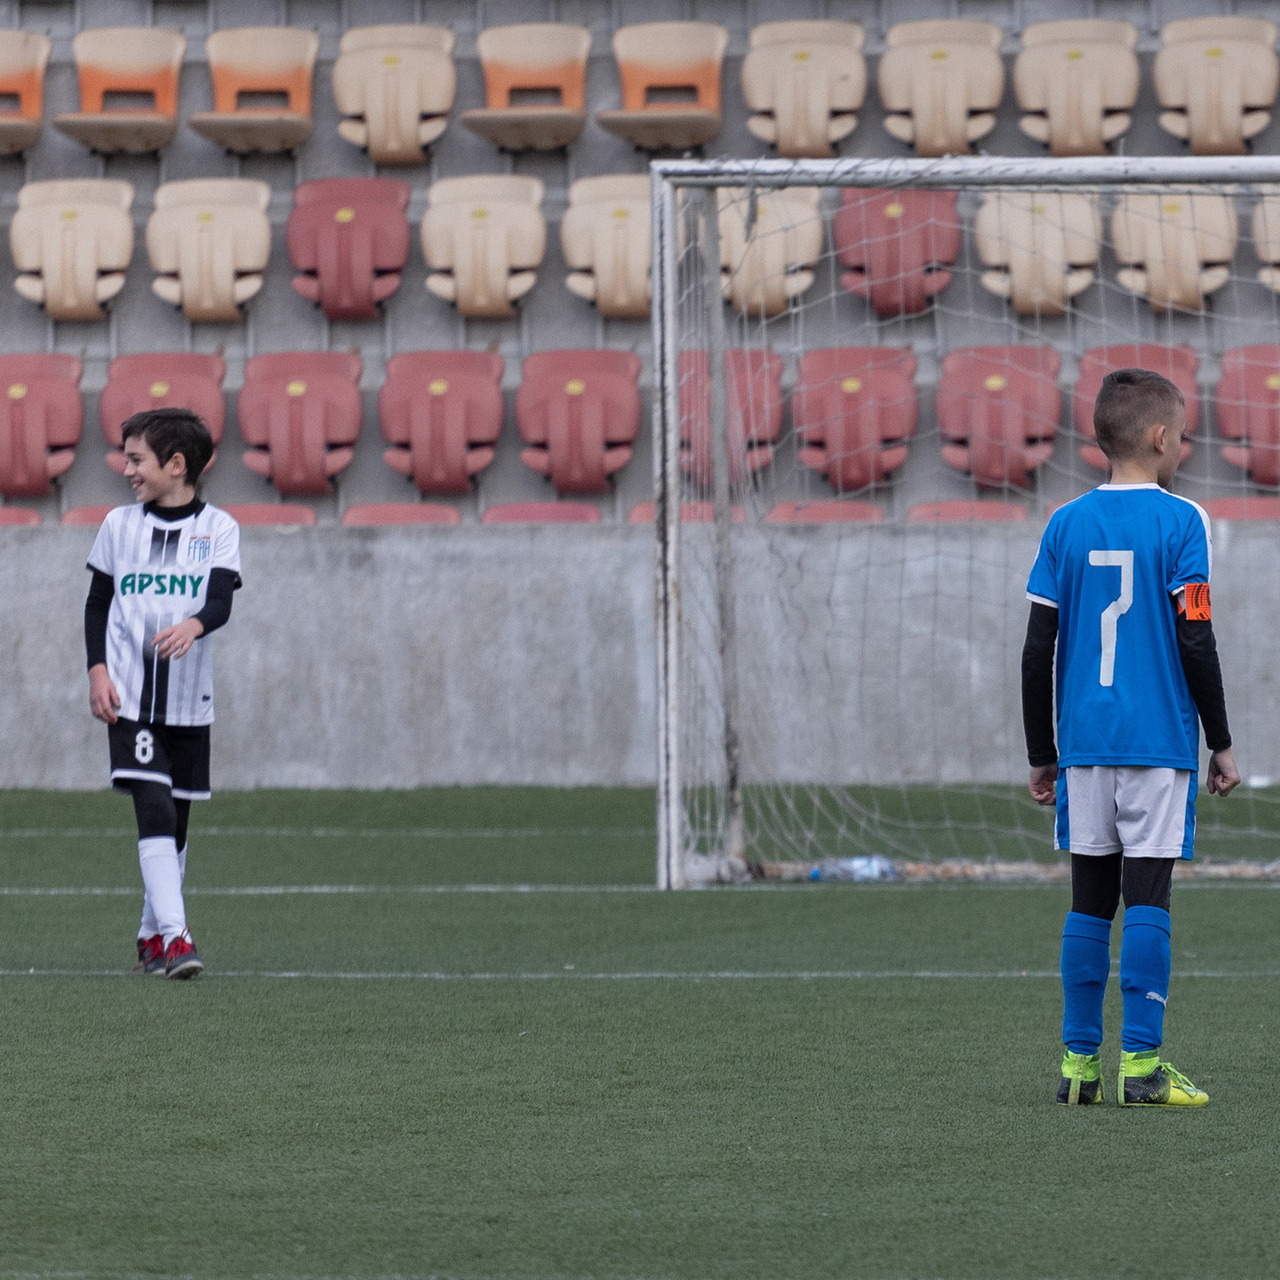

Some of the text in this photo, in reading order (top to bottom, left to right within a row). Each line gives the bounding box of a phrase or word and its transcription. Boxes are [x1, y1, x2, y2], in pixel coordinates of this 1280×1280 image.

[120, 573, 204, 599] APSNY
[1089, 550, 1134, 687] 7
[135, 728, 154, 764] 8
